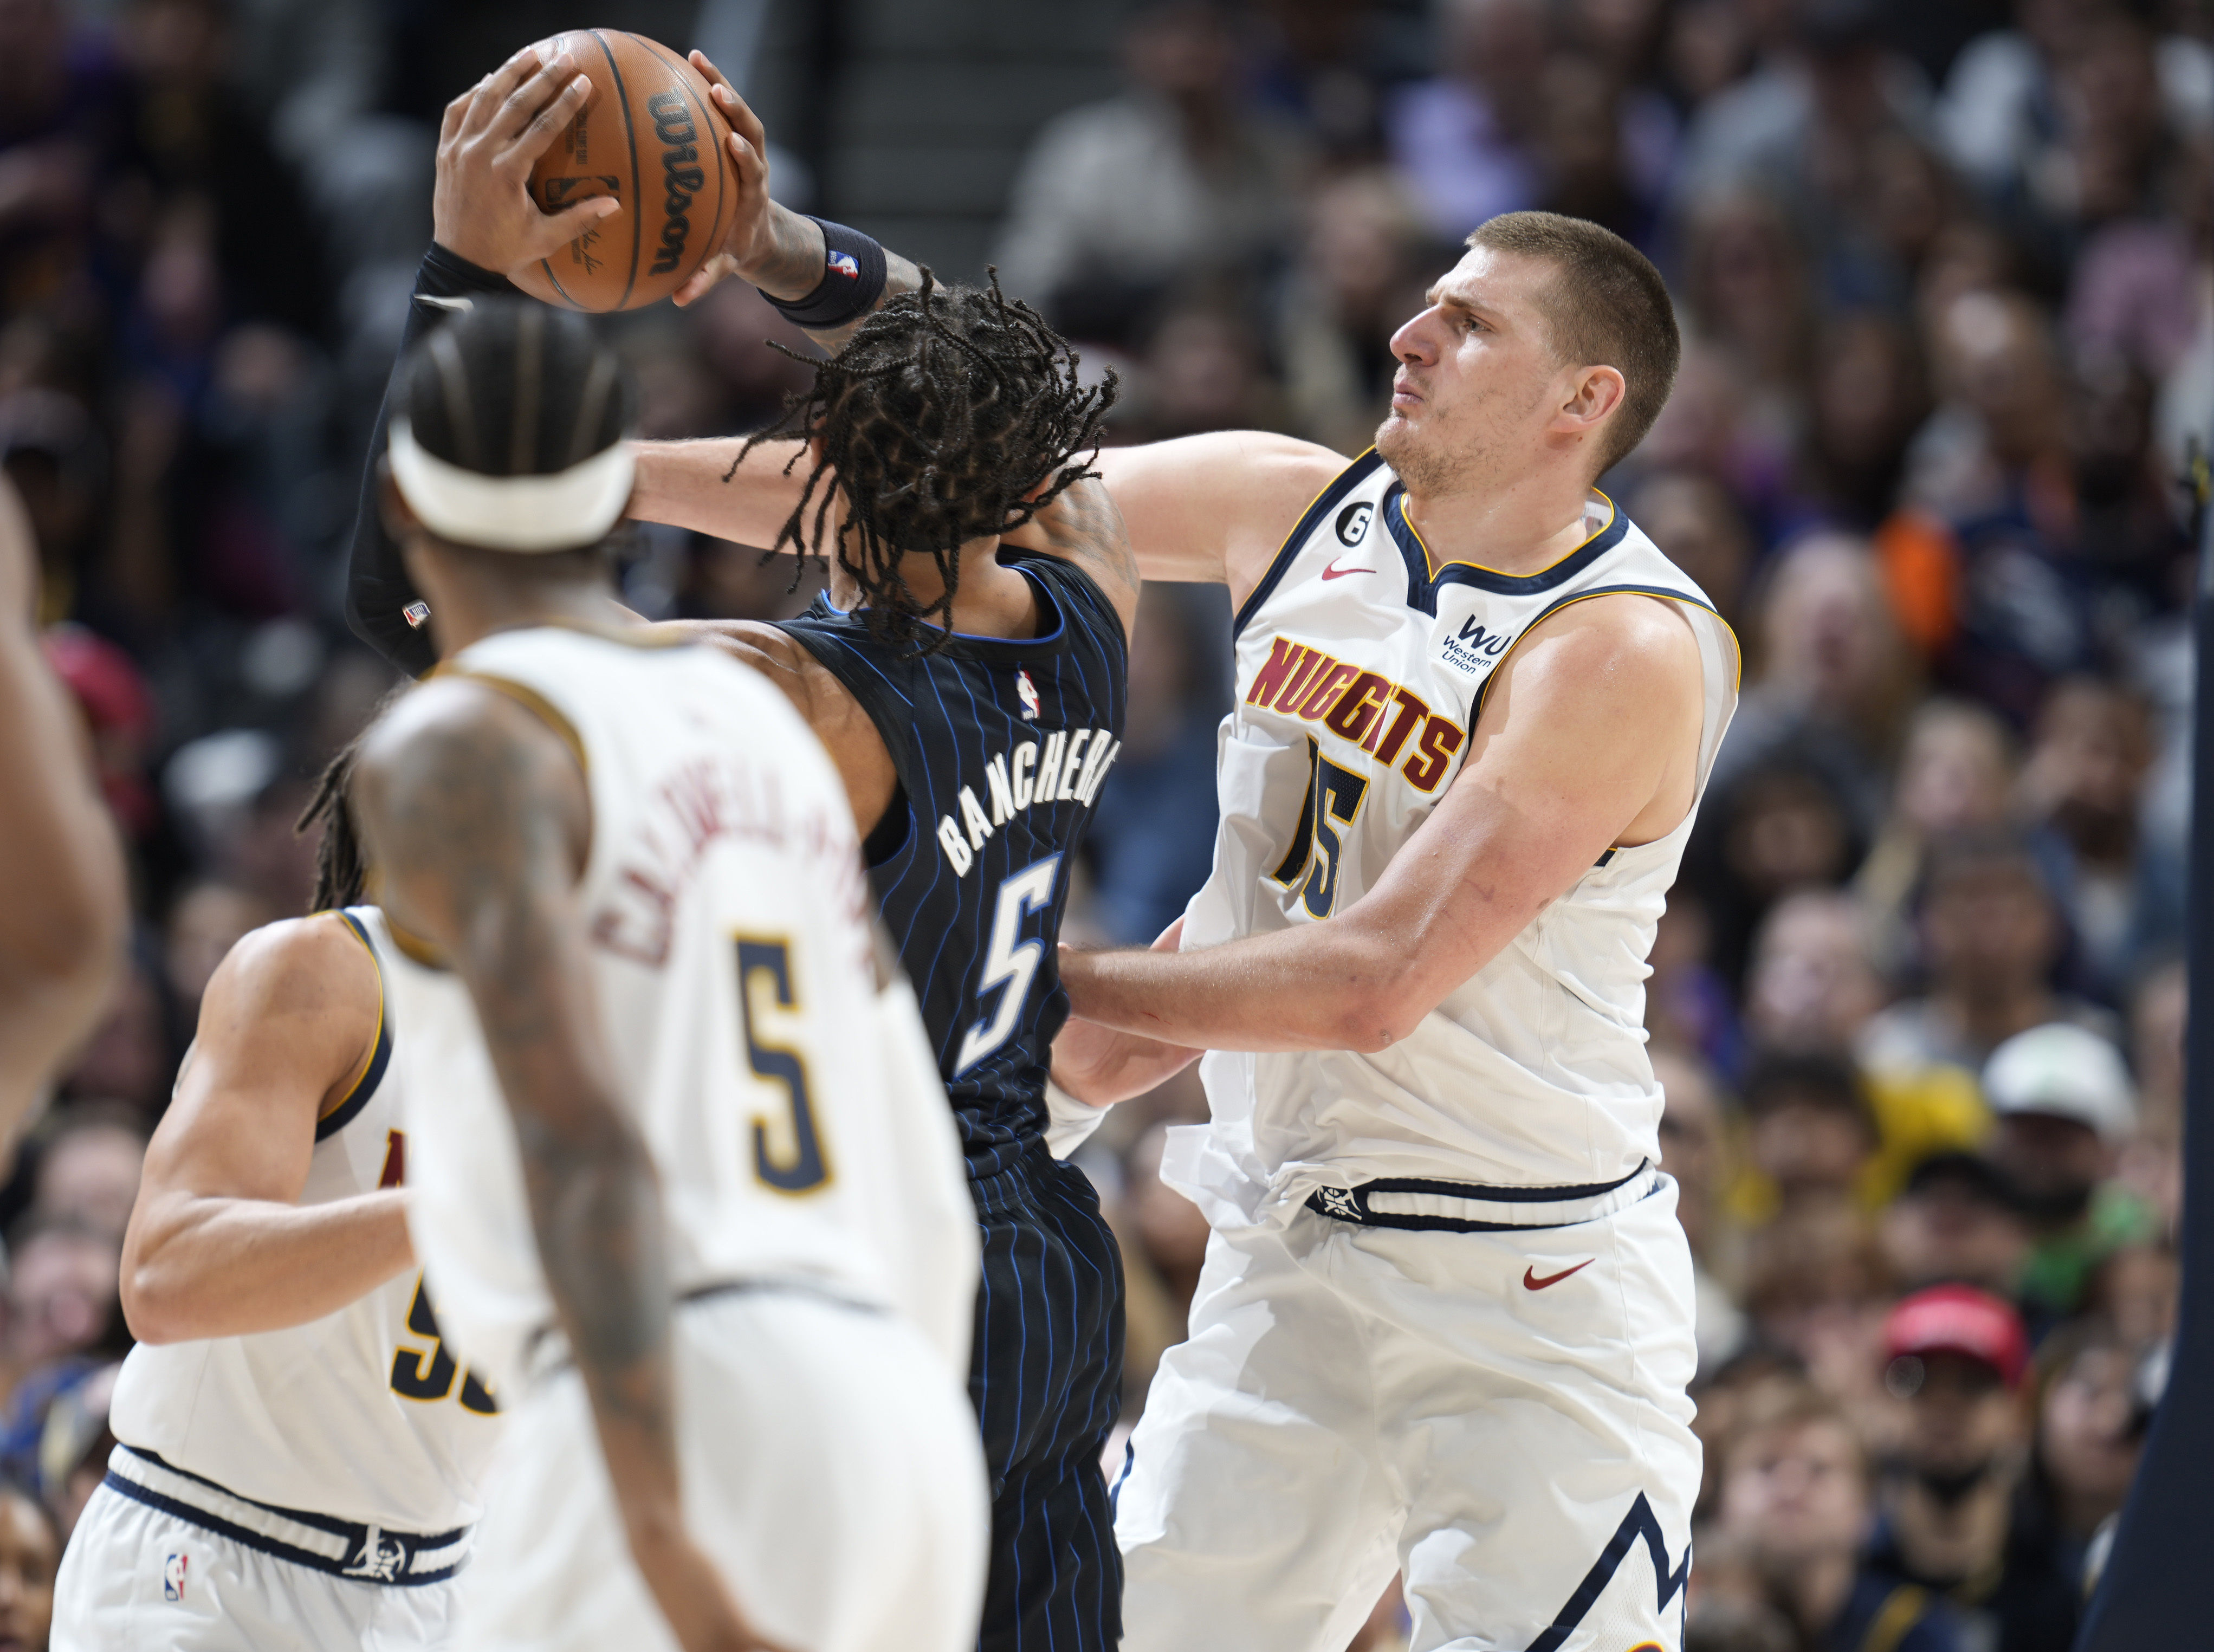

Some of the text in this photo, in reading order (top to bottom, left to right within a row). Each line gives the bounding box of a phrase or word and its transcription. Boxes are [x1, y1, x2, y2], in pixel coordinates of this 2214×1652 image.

[646, 86, 705, 277] Wilson
[1343, 507, 1372, 543] 6
[1443, 635, 1492, 668] Western
[1458, 613, 1512, 656] WU
[1442, 651, 1476, 674] Union
[1022, 709, 1033, 720] NBA
[1270, 733, 1370, 920] 15
[953, 850, 1065, 1081] 5
[733, 931, 835, 1194] 5
